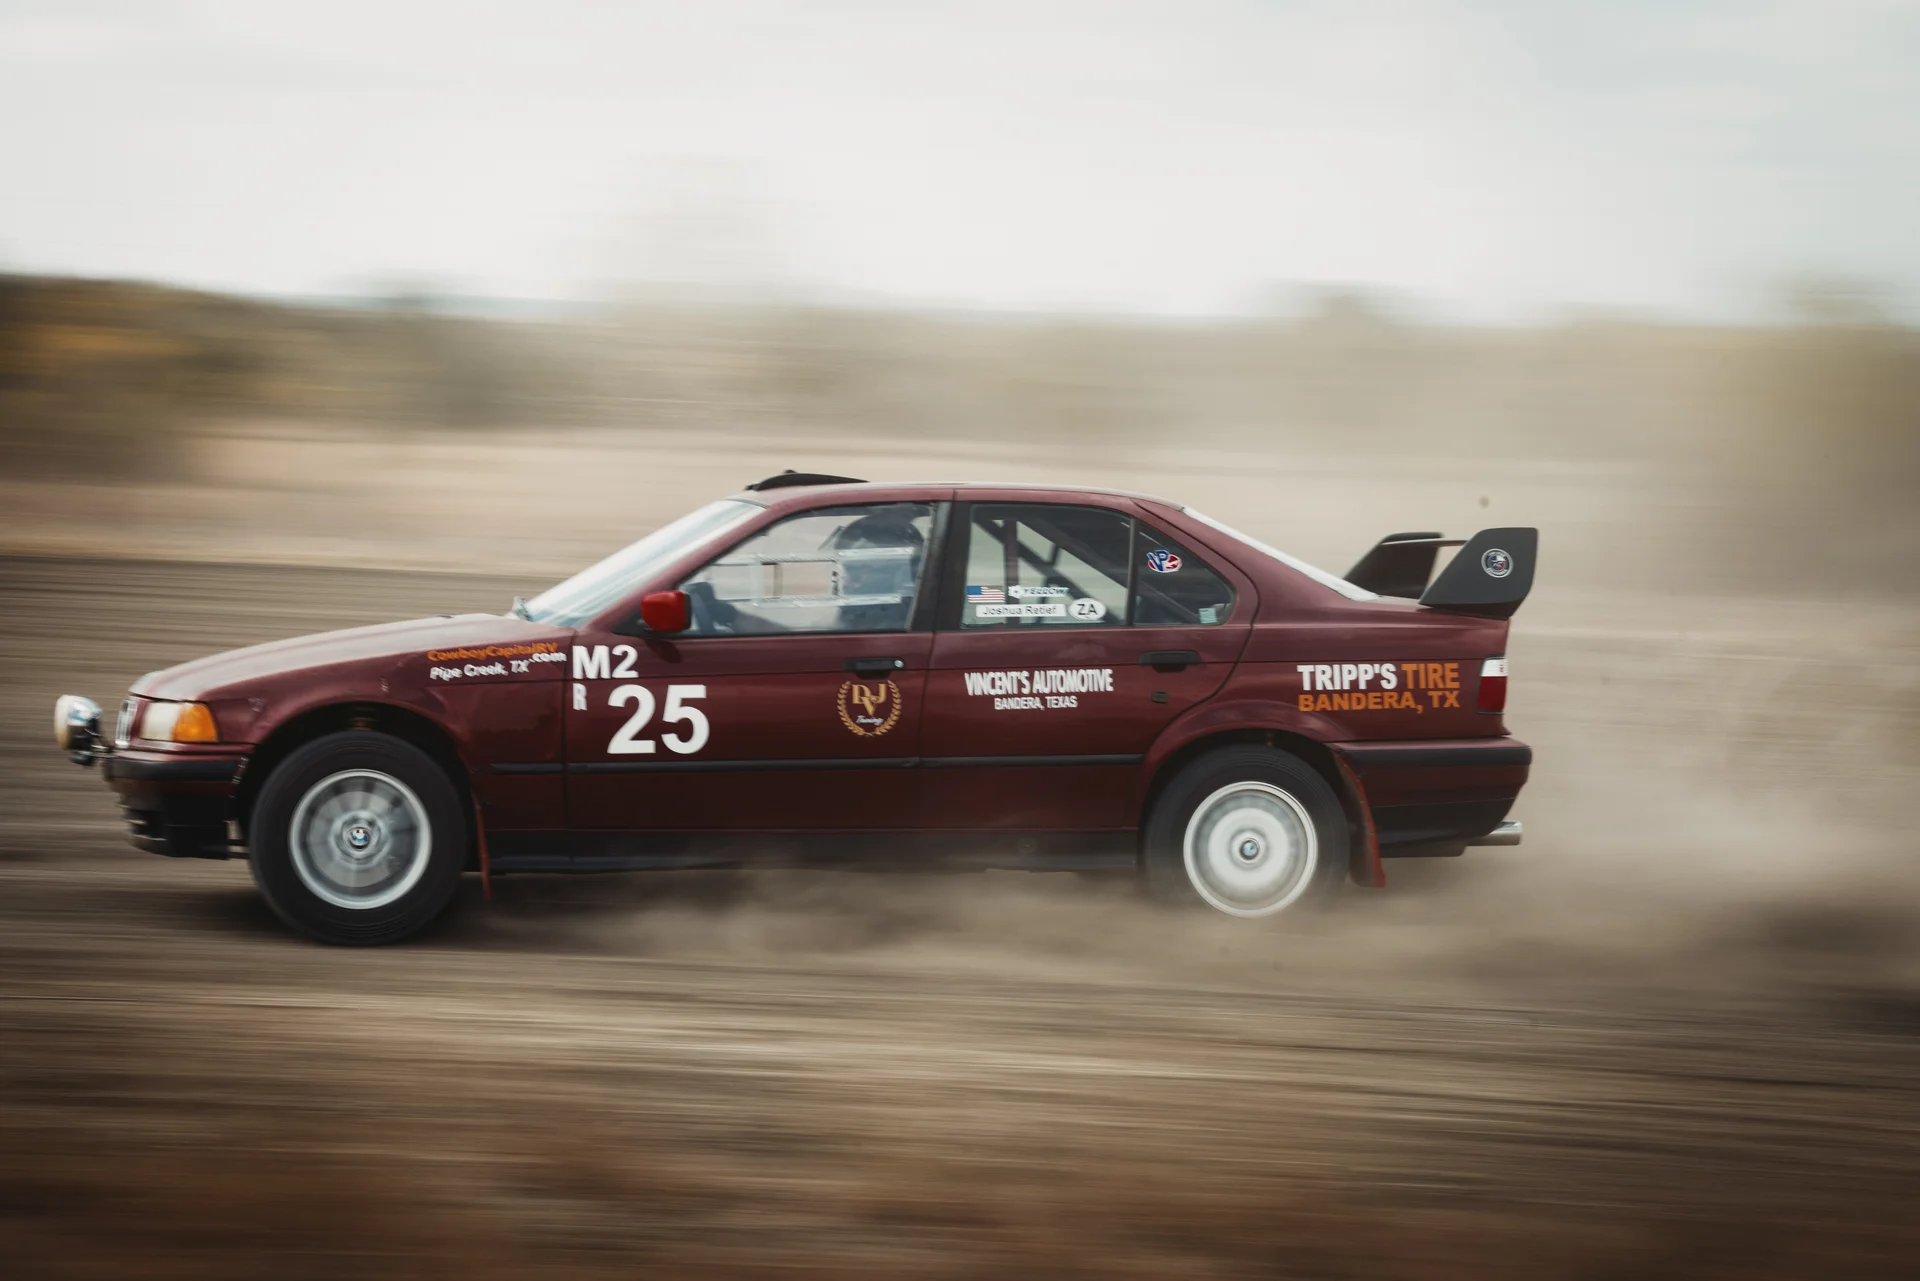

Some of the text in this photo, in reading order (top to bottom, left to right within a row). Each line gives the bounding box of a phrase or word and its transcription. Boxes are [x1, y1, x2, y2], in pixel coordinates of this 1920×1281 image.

[982, 605, 1058, 616] Joshua Retief
[1076, 603, 1099, 616] ZA
[429, 659, 530, 682] Pipe Creek, TX
[572, 645, 639, 679] M2
[964, 668, 1115, 696] VINCENT'S AUTOMOTIVE
[1296, 663, 1461, 691] TRIPP'S TIRE
[572, 682, 588, 711] R
[994, 695, 1079, 711] BANDERA, TEXAS
[1298, 690, 1461, 714] BANDERA, TX
[607, 684, 710, 754] 25
